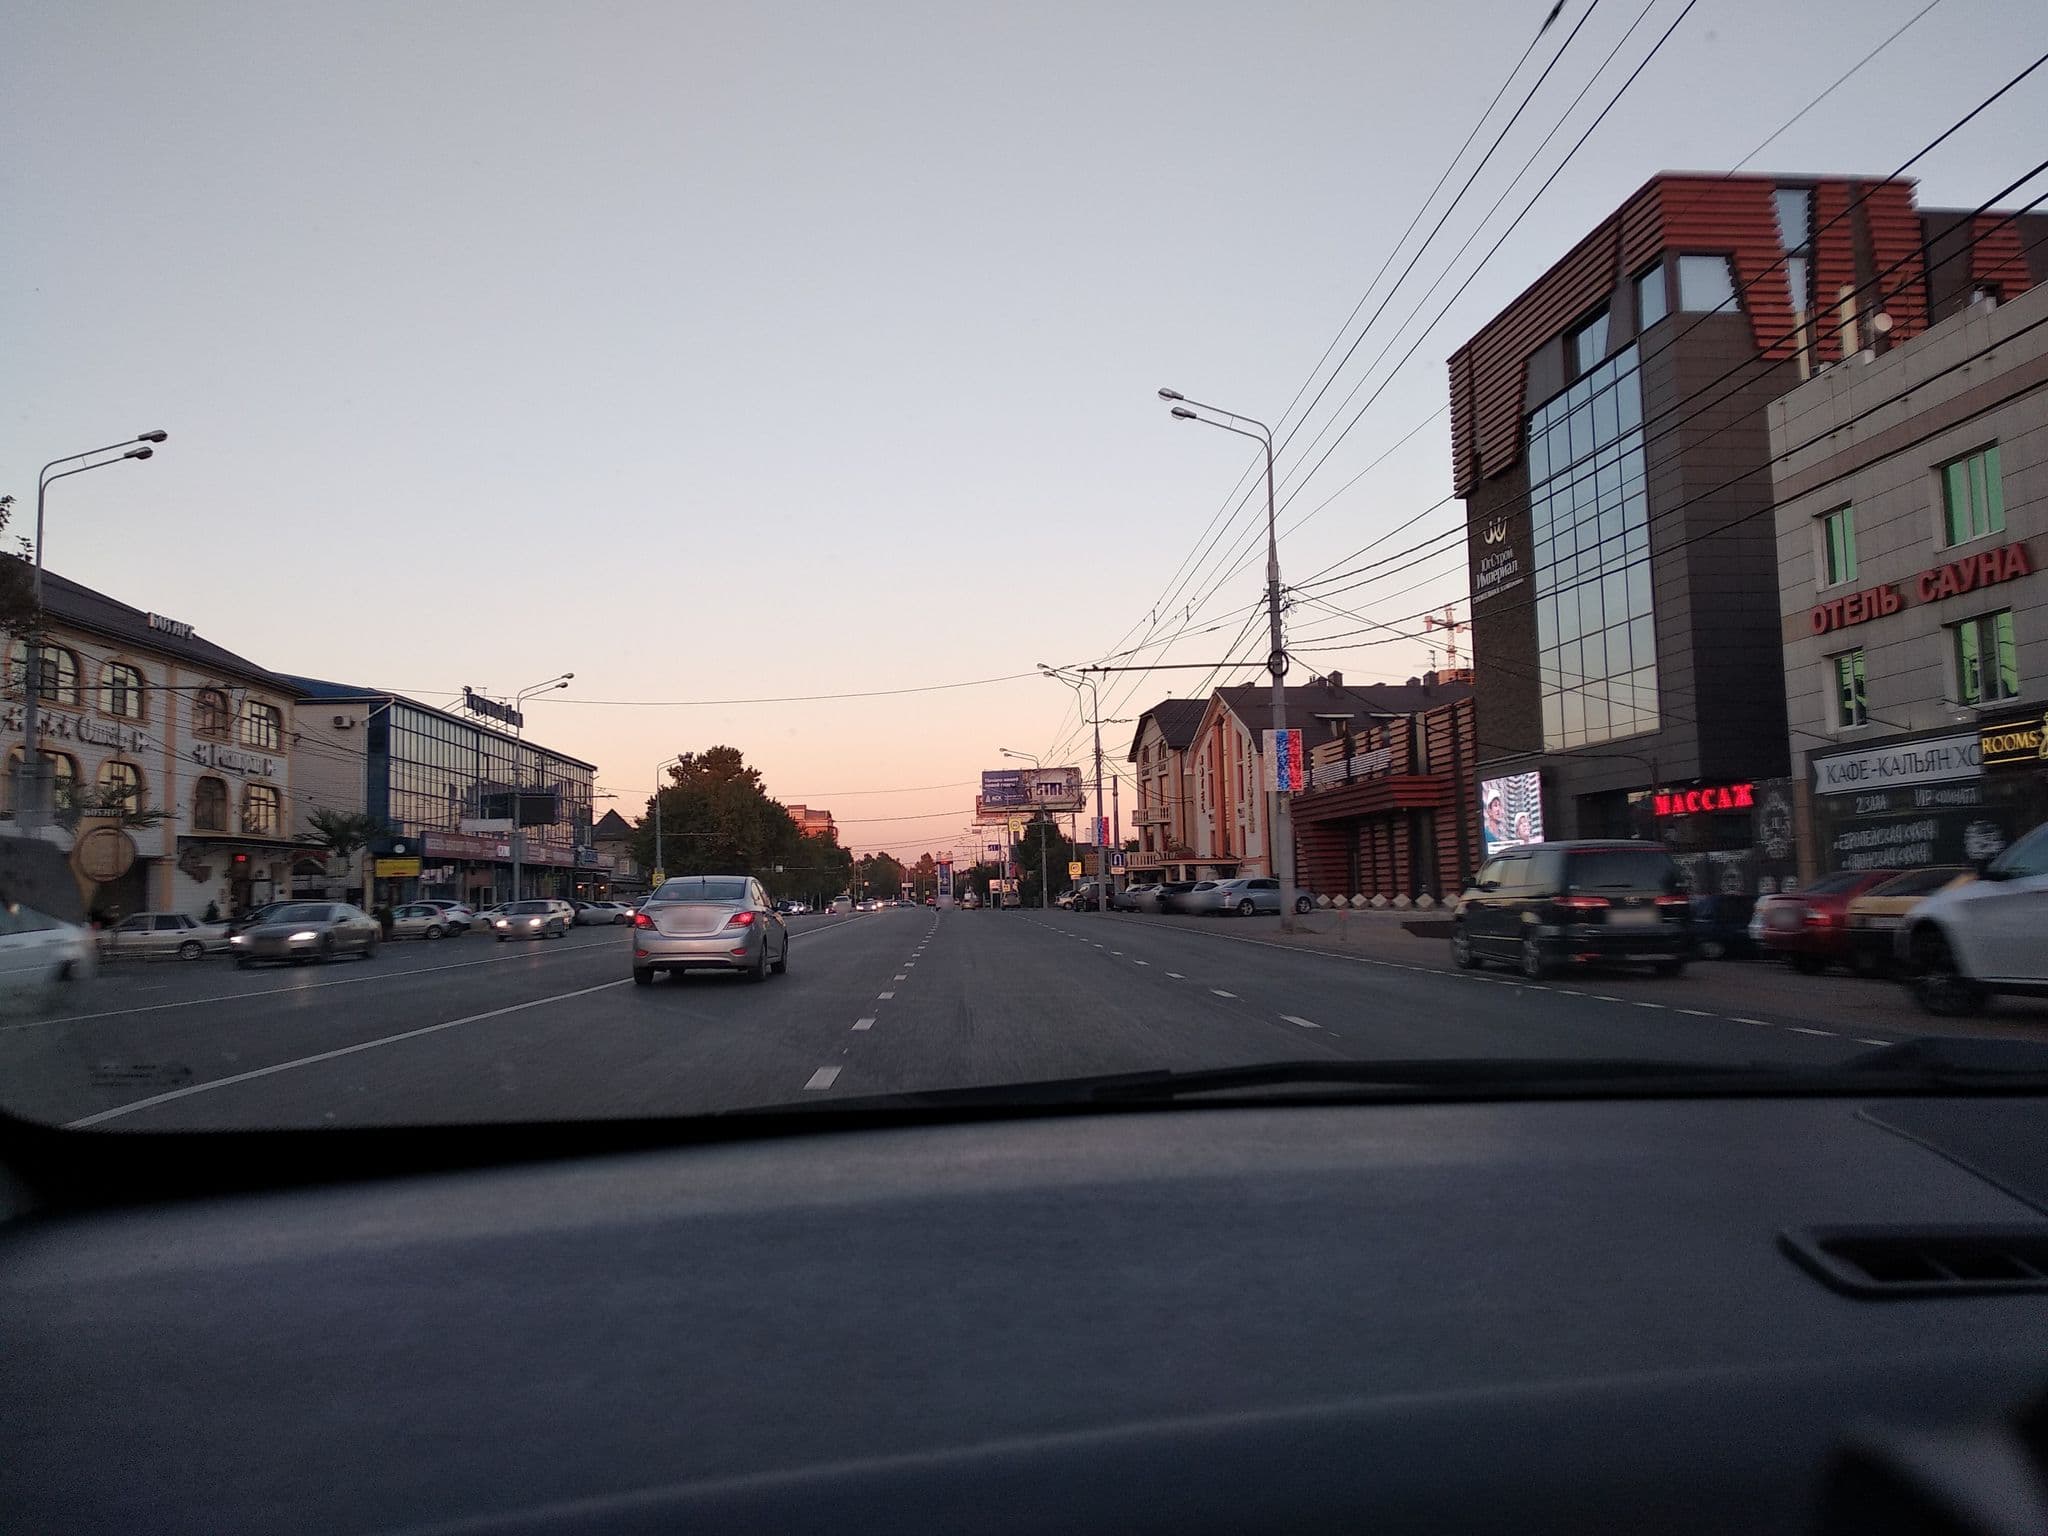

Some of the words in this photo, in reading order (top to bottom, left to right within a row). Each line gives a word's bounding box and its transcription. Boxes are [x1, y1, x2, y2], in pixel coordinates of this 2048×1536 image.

[1476, 559, 1518, 590] Империал
[1810, 583, 1902, 635] ОТЕЛЬ
[1915, 542, 2031, 603] САУНА
[1981, 730, 2038, 755] ROOMS
[1825, 749, 1950, 785] КАФЕ-КАЛЬЯН
[1654, 783, 1754, 816] МАССАЖ
